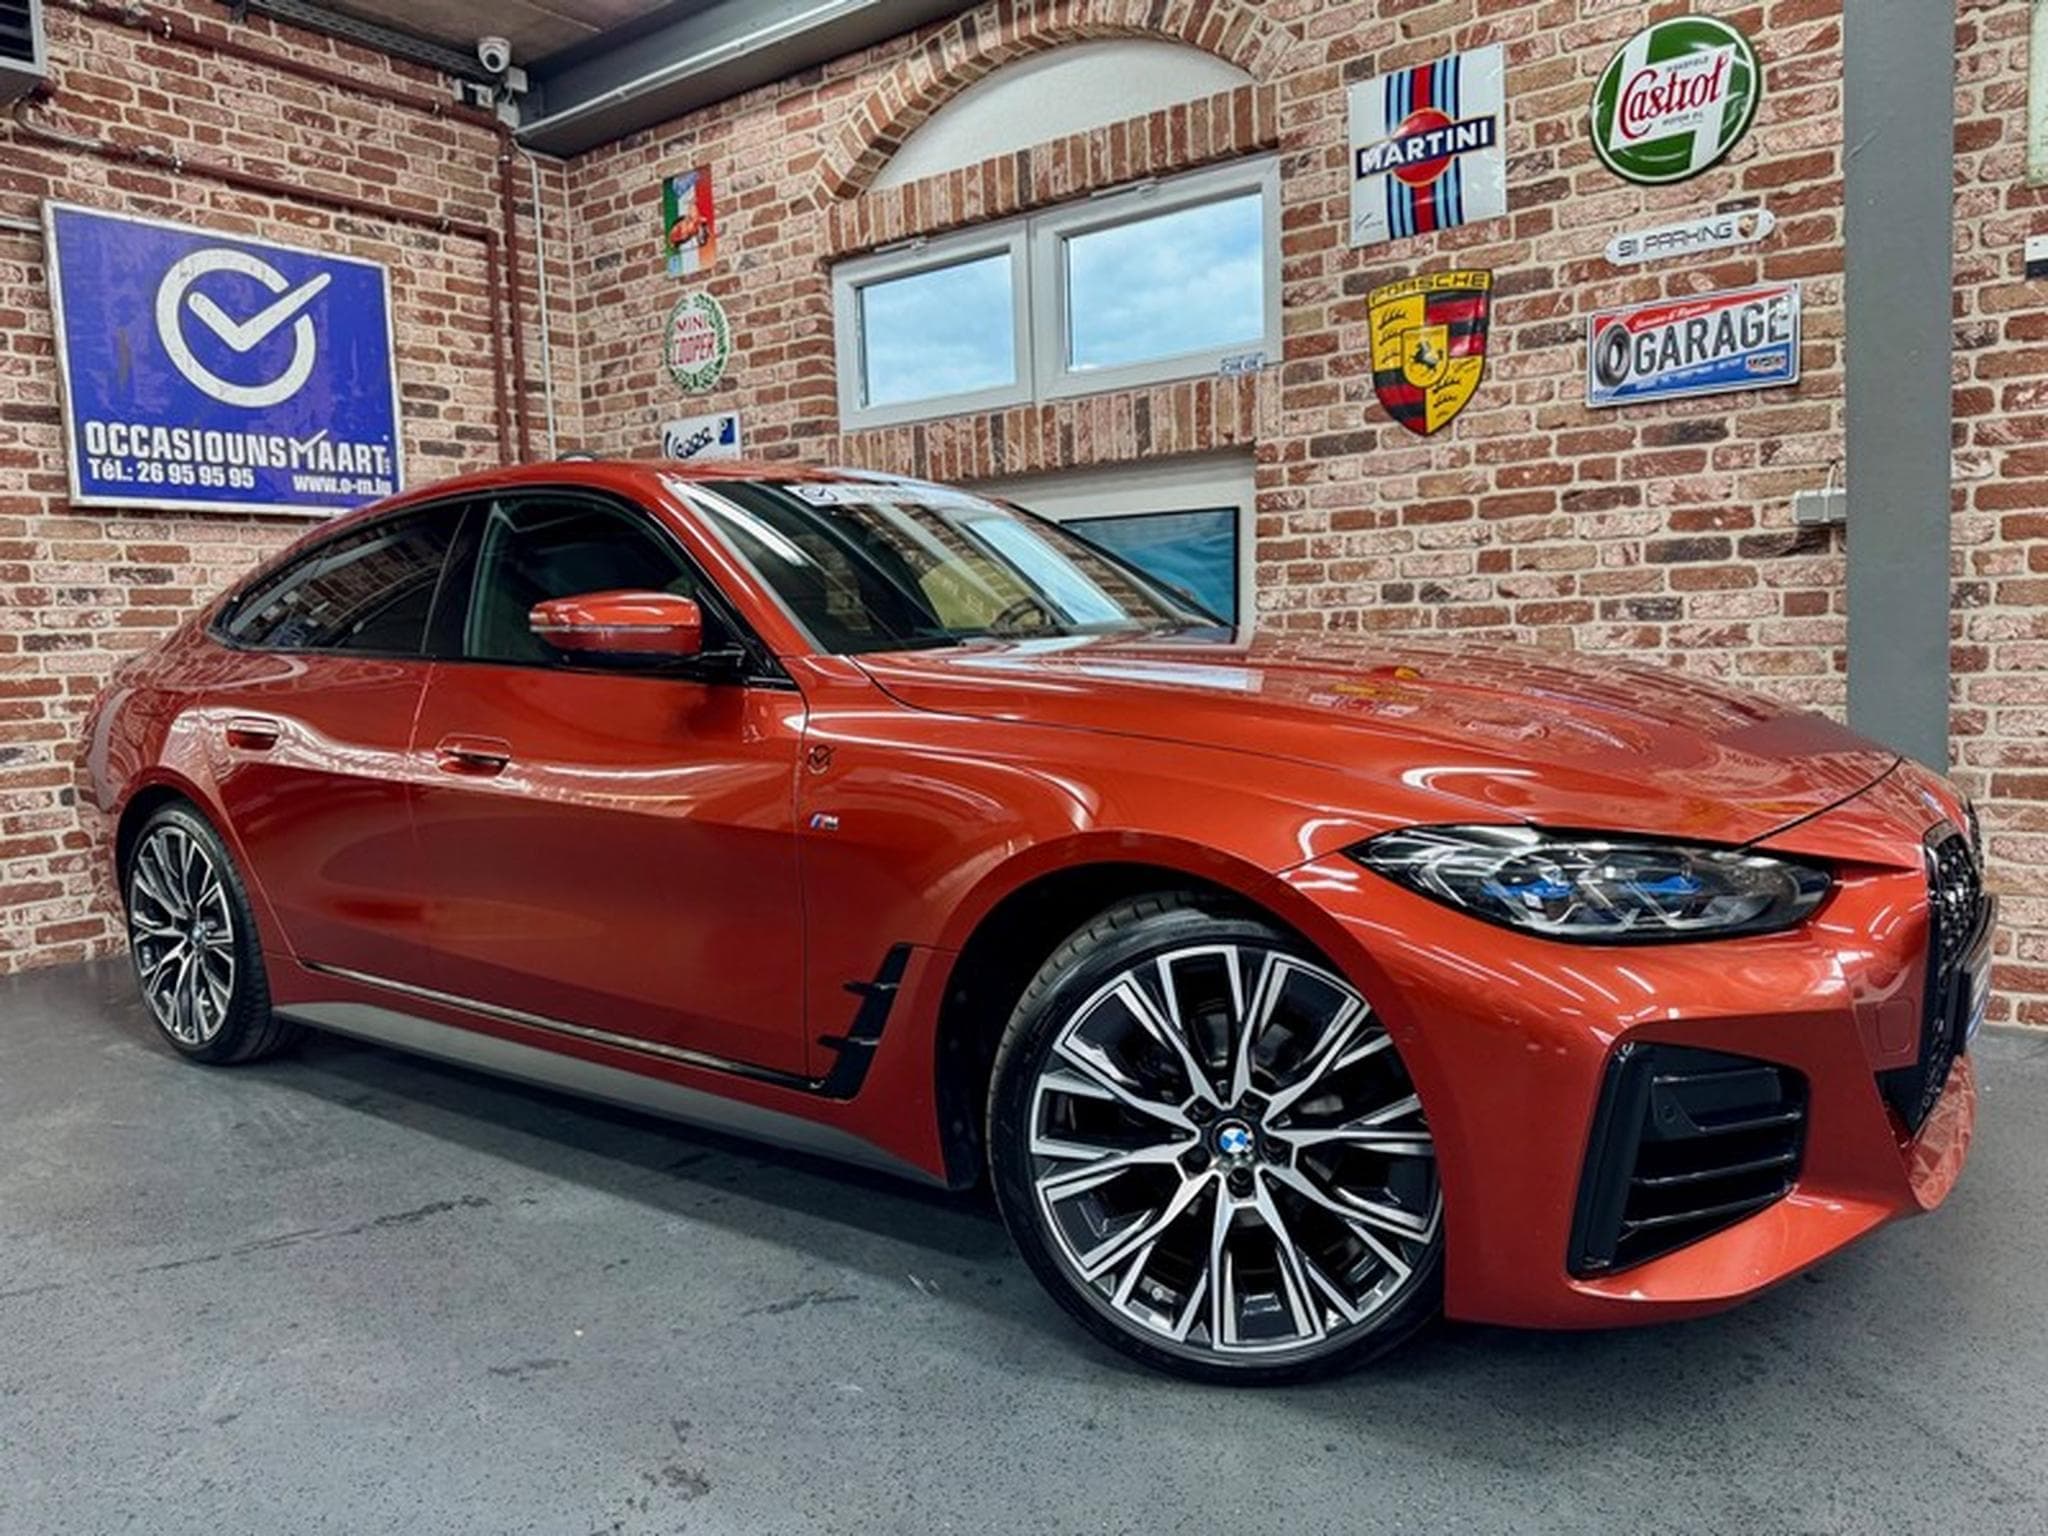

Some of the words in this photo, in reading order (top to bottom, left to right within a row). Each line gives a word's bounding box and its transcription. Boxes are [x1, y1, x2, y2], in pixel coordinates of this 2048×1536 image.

[1619, 54, 1729, 140] Castrol
[1361, 119, 1489, 174] MARTINI
[1372, 272, 1485, 304] PORSCHE
[1634, 294, 1791, 376] GARAGE
[136, 461, 164, 484] 26
[168, 463, 195, 485] 95
[199, 465, 225, 487] 95
[229, 467, 255, 489] 95
[292, 474, 393, 497] www.o-m.lu
